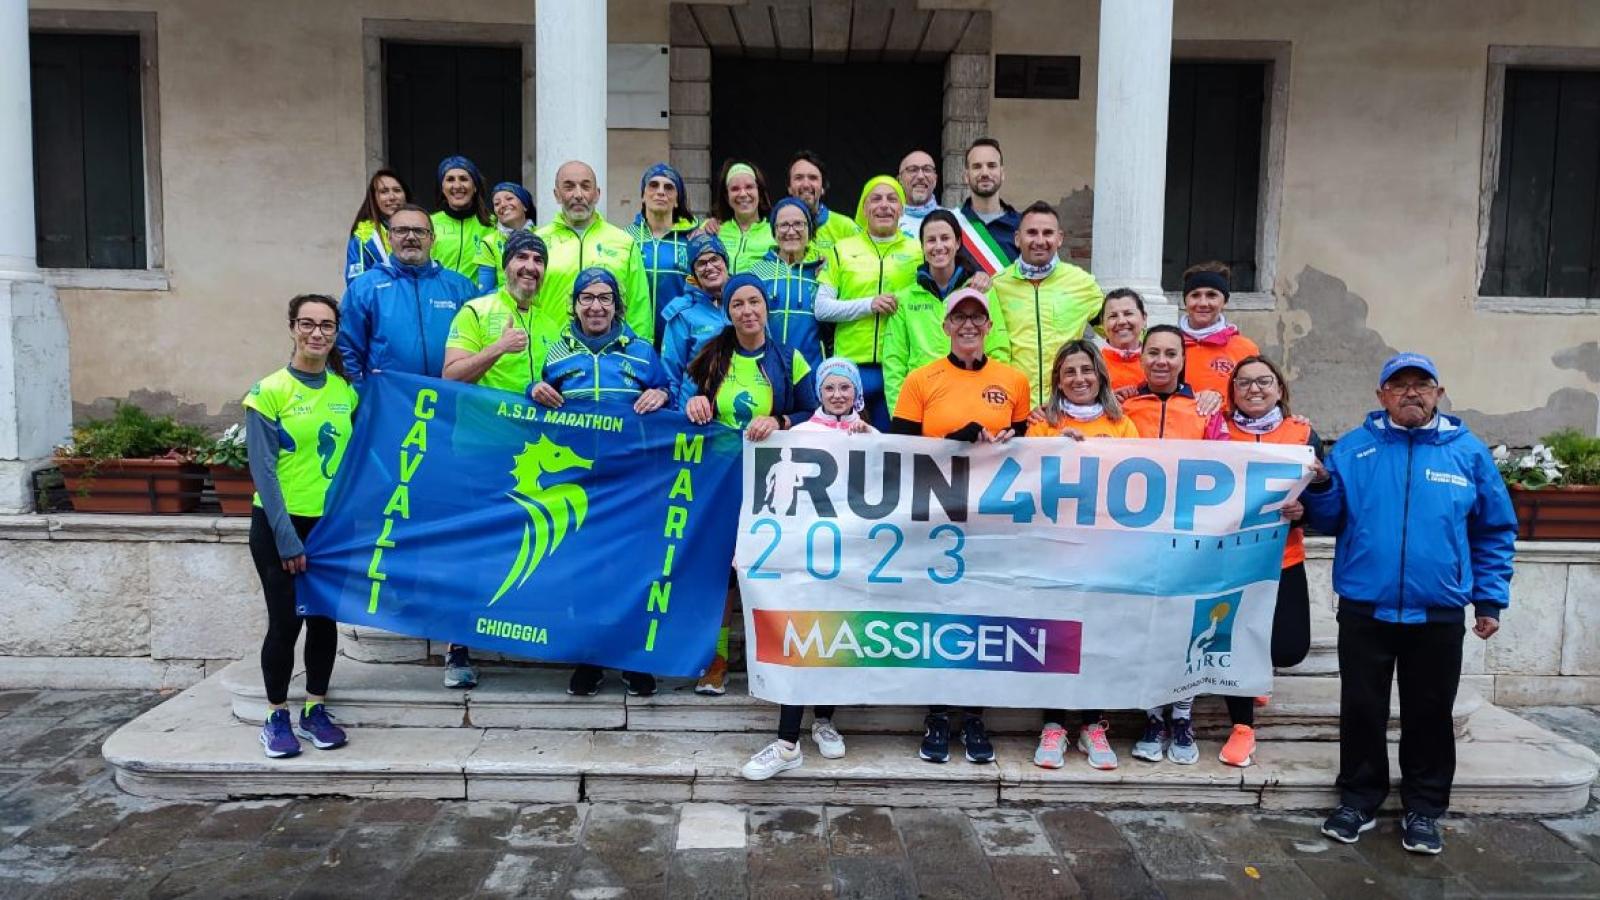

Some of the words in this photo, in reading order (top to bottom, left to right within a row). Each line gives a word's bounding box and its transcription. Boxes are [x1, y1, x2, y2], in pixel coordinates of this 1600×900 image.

[497, 401, 539, 421] A.S.D.
[543, 410, 624, 433] MARATHON
[367, 389, 438, 614] CAVALLI
[645, 432, 704, 652] MARINI
[746, 518, 967, 585] 2023
[1172, 530, 1279, 550] ITALIA
[476, 617, 549, 645] CHIOGGIA
[782, 617, 1047, 666] MASSIGEN
[1185, 654, 1231, 676] AIRC
[1219, 680, 1240, 688] AIRC
